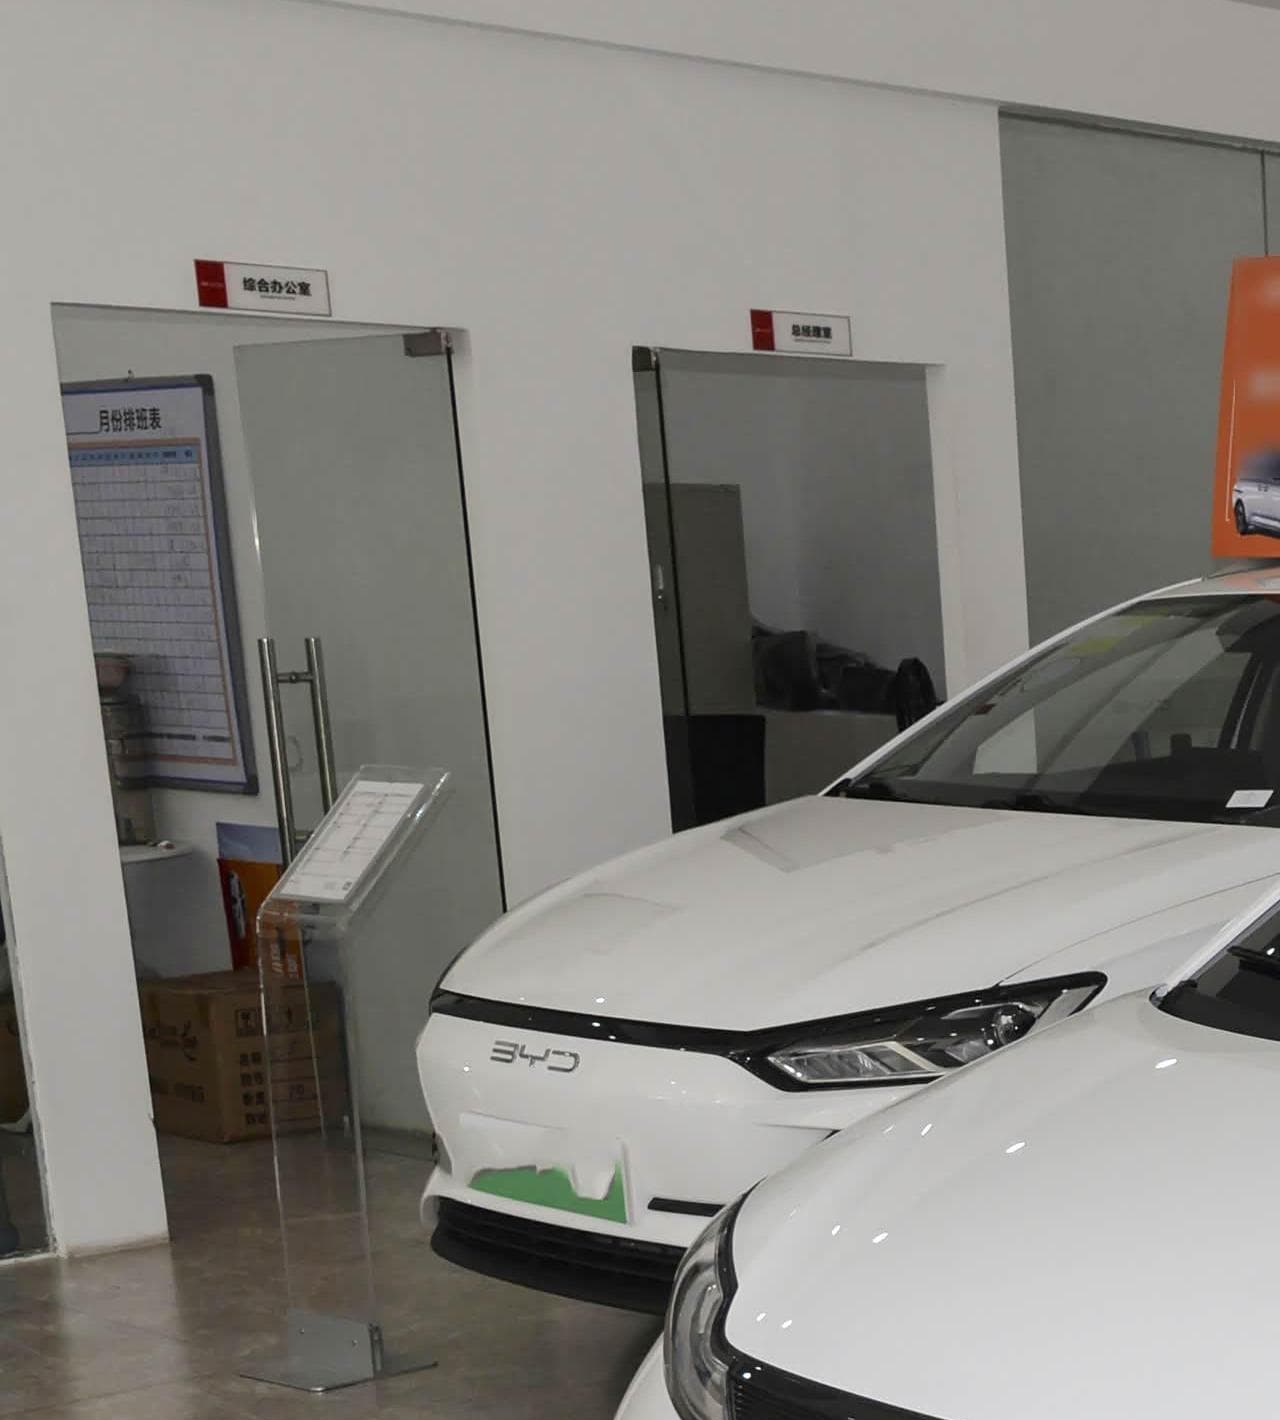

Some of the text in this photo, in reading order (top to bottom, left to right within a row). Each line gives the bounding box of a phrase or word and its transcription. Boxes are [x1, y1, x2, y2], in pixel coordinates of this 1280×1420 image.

[243, 276, 312, 297] 综合办公室
[99, 407, 162, 432] 月份排班表
[490, 1040, 580, 1073] BYD
